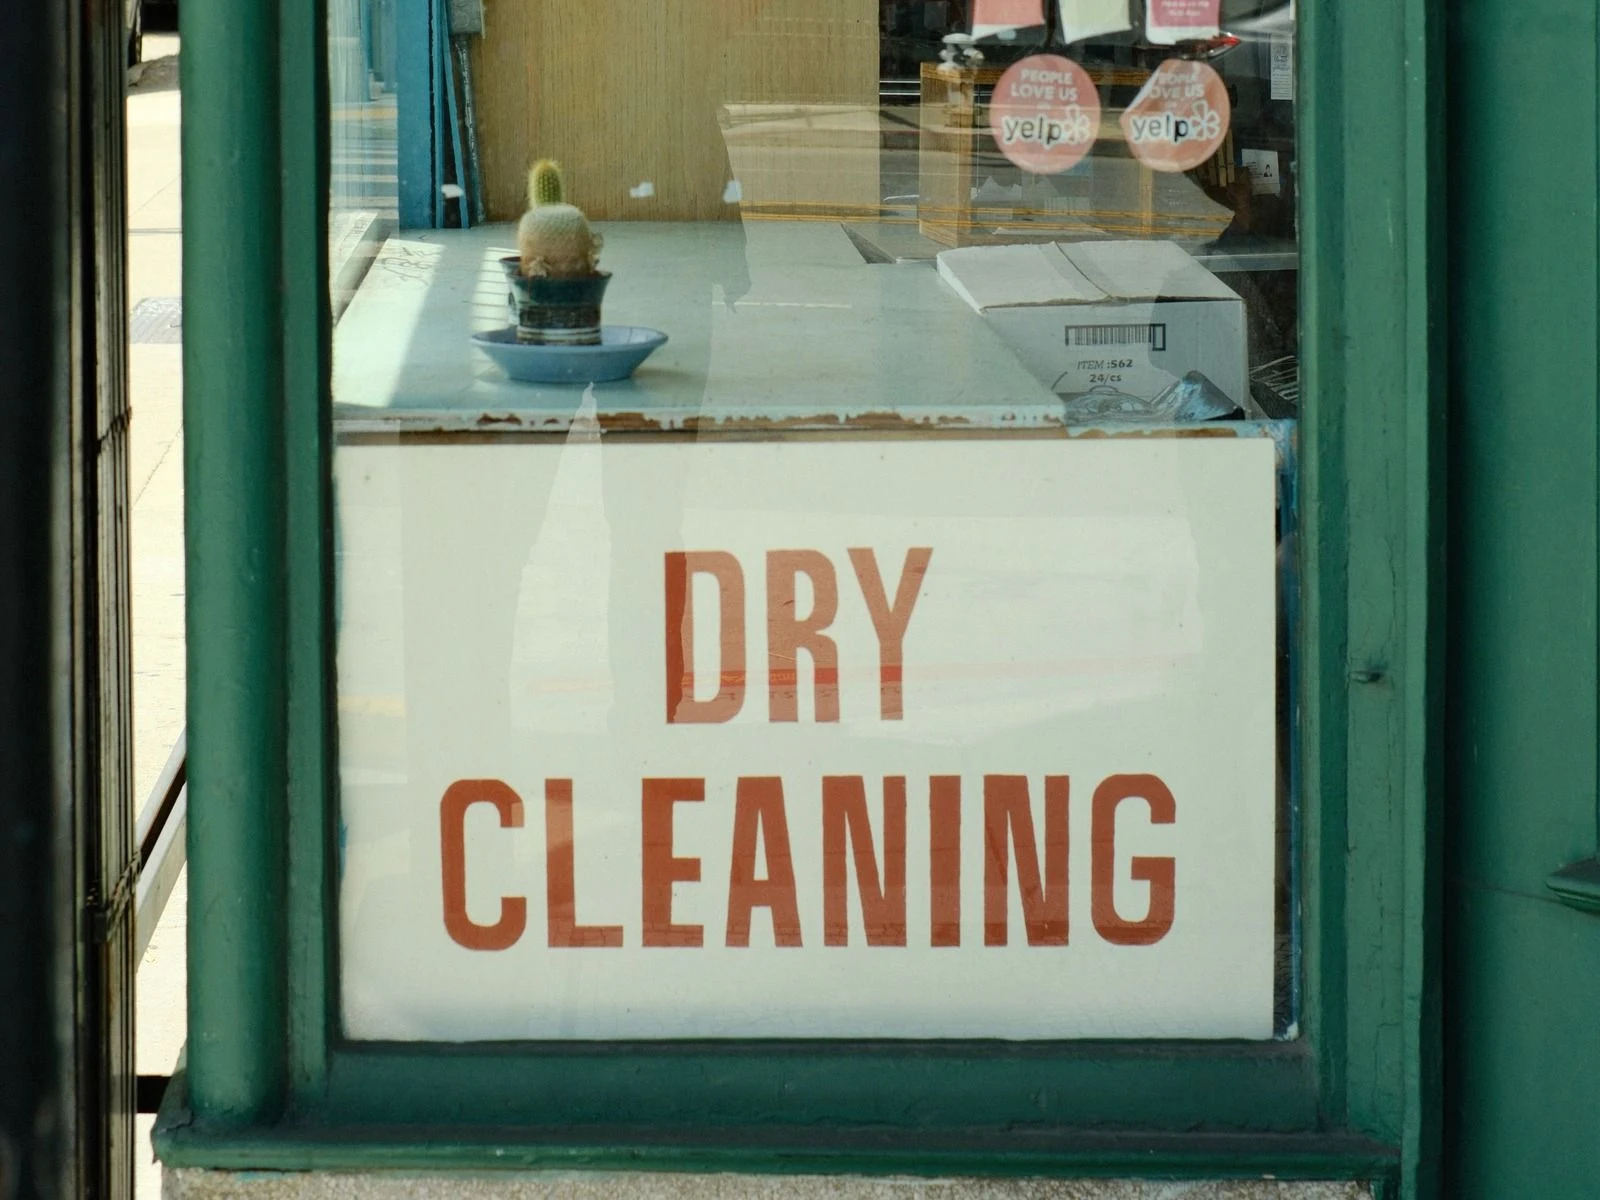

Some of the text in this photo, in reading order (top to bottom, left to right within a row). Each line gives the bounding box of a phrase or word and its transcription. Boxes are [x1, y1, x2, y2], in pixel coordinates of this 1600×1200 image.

[1011, 82, 1078, 101] LOVE US
[1020, 68, 1073, 86] PEOPLE
[1150, 84, 1206, 98] OVE US
[1005, 116, 1063, 145] yelp
[1131, 114, 1190, 144] yelp
[663, 545, 935, 725] DRY
[439, 773, 1178, 952] CLEANING
